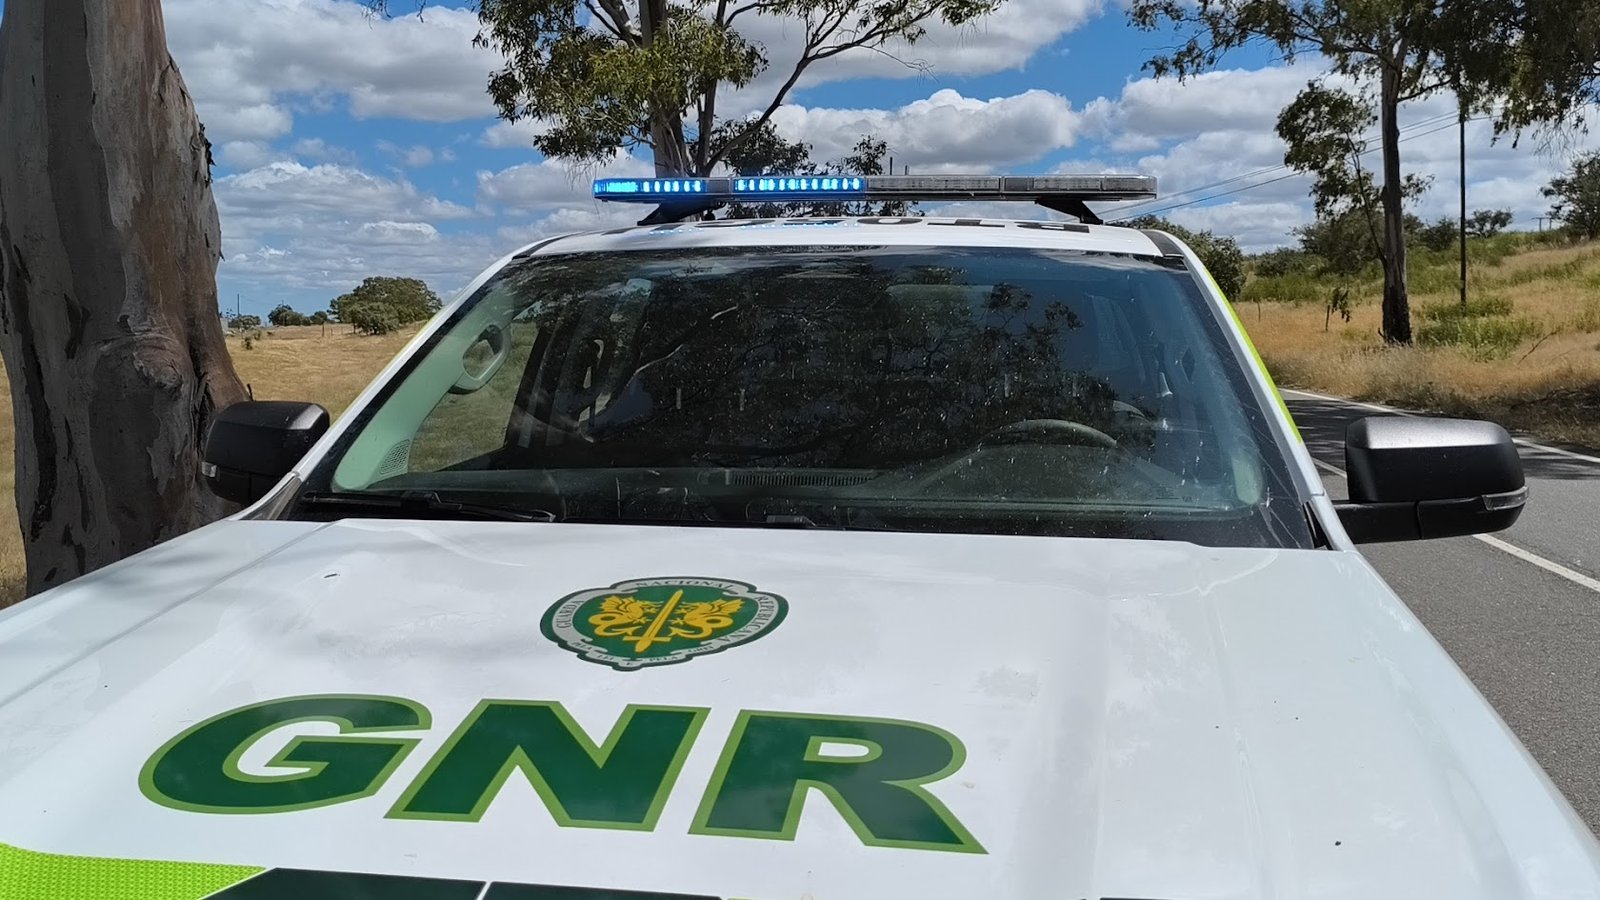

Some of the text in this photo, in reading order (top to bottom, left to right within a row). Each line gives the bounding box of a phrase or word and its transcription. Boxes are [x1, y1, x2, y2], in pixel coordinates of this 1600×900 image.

[557, 580, 774, 644] GUARDA NACIONAL REPUBLICANA
[138, 693, 989, 855] GNR
